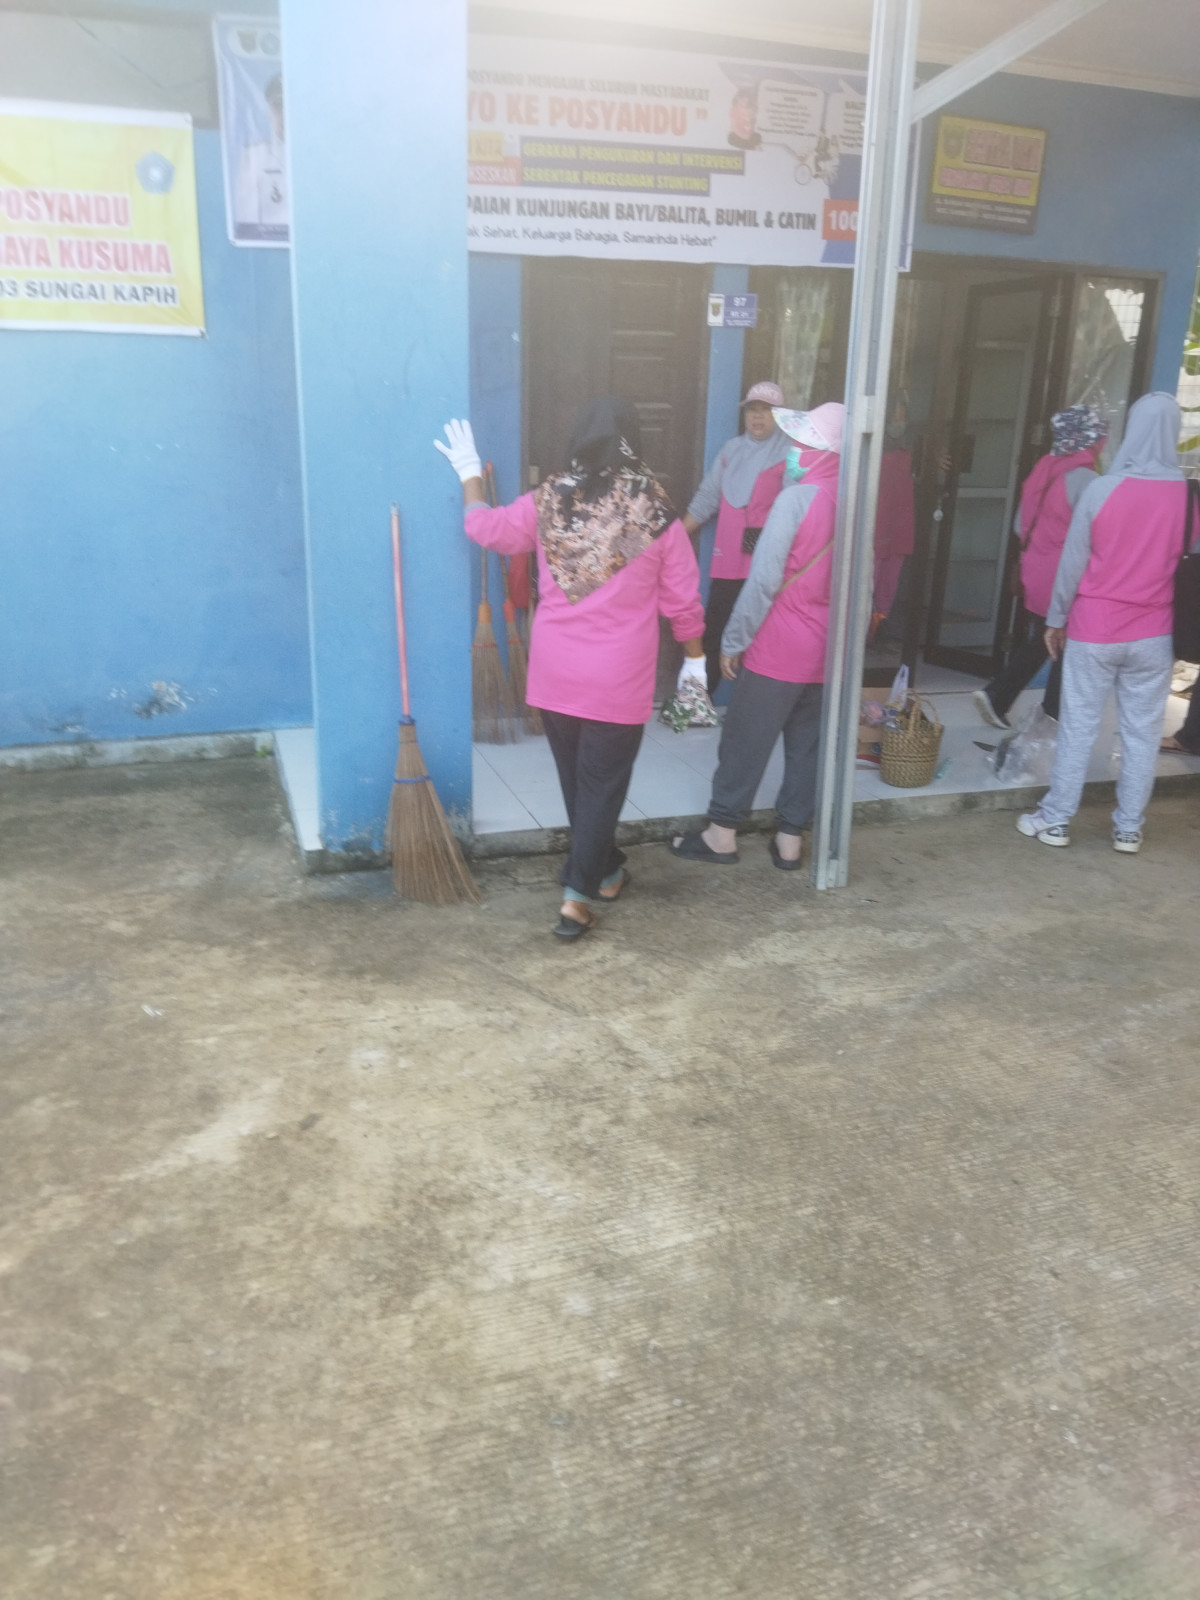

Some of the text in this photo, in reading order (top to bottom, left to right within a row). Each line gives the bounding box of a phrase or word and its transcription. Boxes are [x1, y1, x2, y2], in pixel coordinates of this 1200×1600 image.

[506, 92, 539, 126] KE
[548, 96, 688, 136] POSYANDU
[0, 188, 130, 227] OSYANDU
[516, 198, 611, 221] KUNJUNGAN
[614, 203, 711, 227] BAYI/BALITA,
[715, 208, 760, 229] BUMIL
[763, 212, 775, 228] &
[777, 211, 817, 231] CATIN
[0, 235, 172, 274] AYA KUSUMA
[25, 279, 106, 300] SUNGAI
[113, 283, 177, 304] KAPIH
